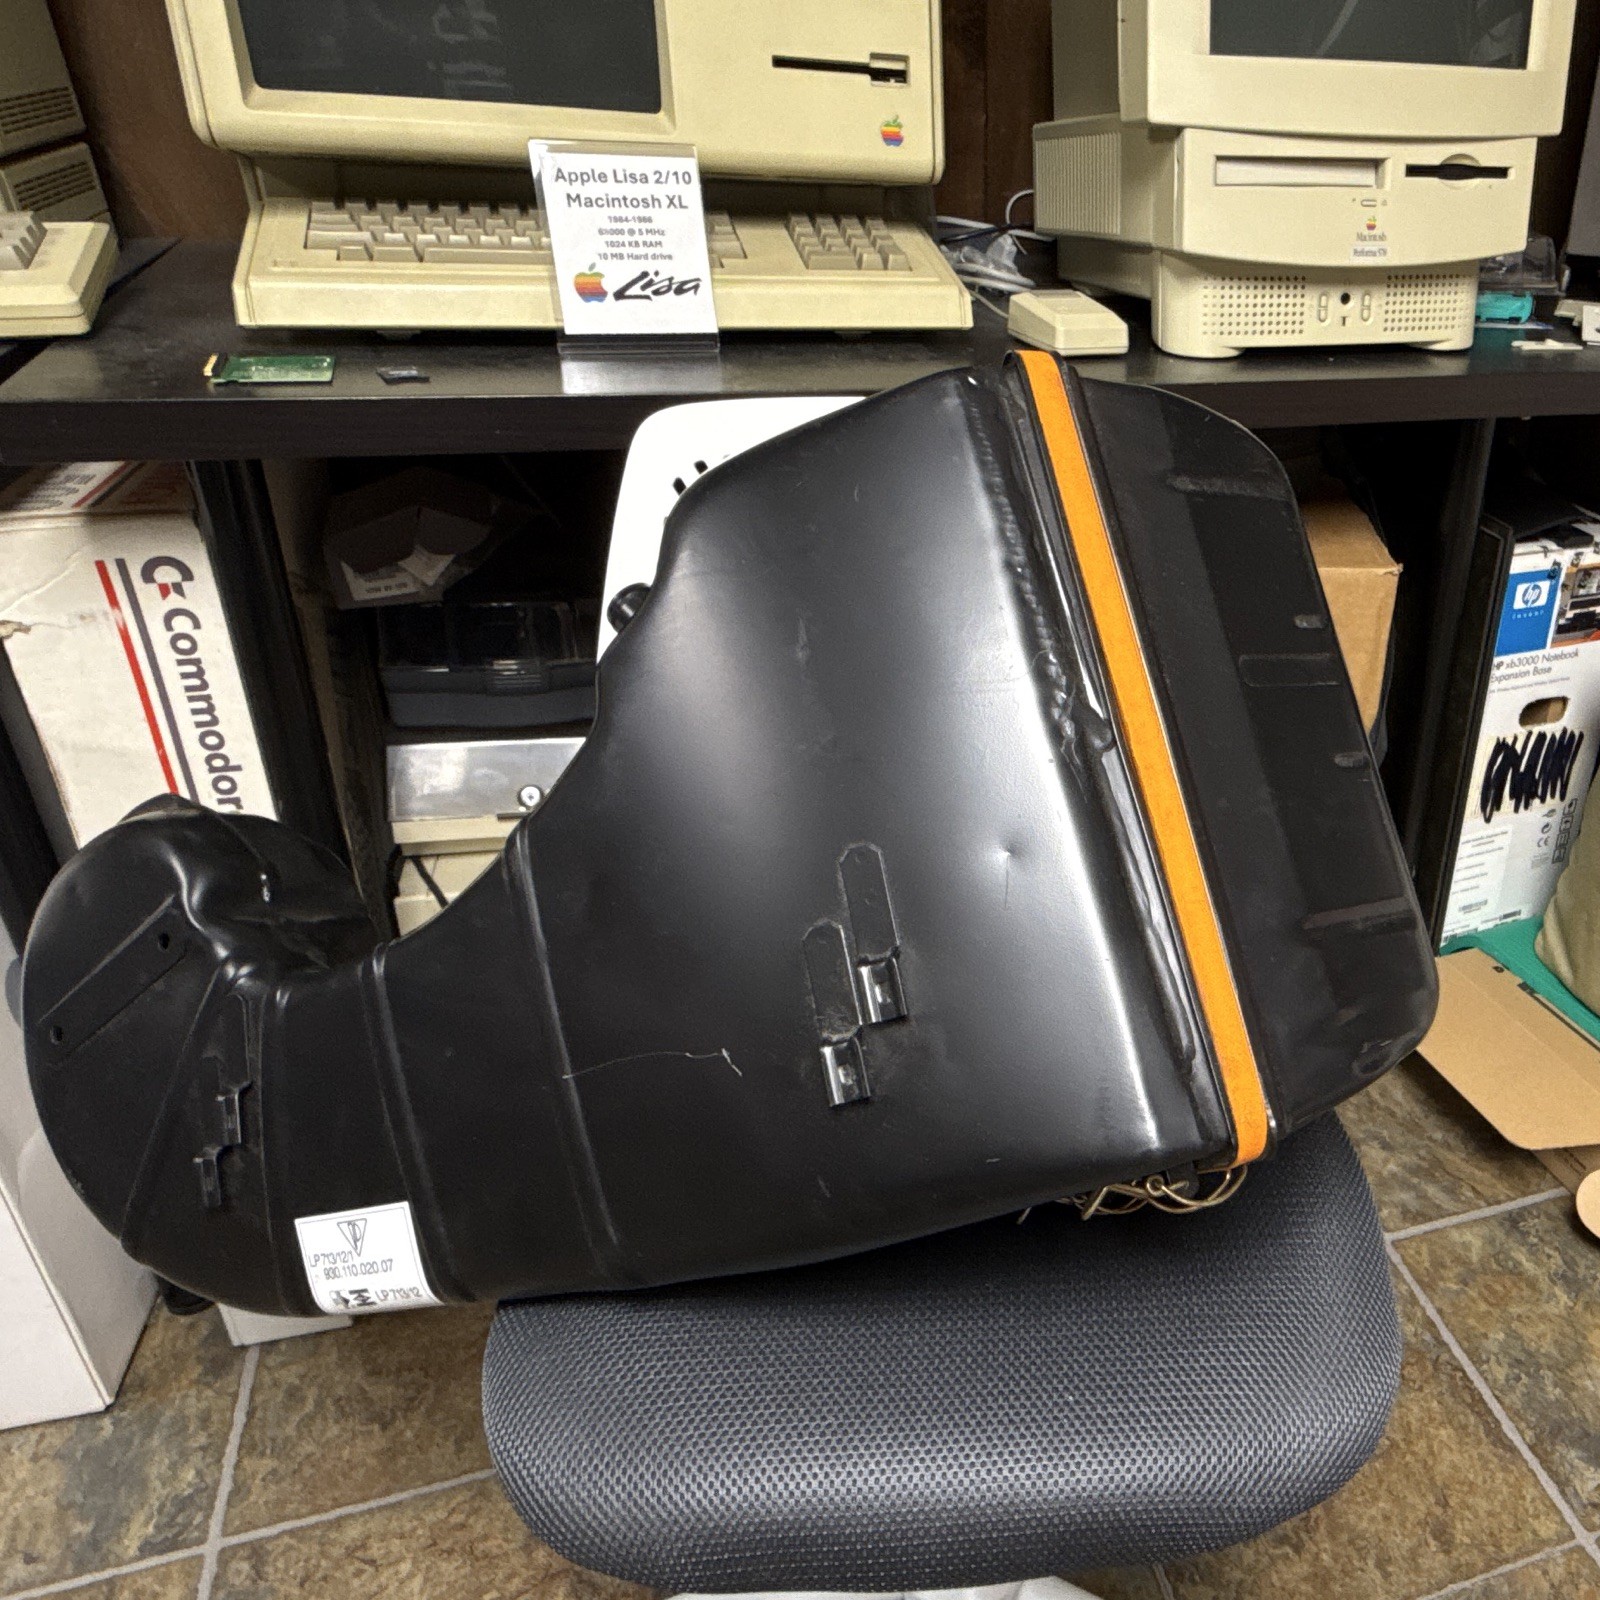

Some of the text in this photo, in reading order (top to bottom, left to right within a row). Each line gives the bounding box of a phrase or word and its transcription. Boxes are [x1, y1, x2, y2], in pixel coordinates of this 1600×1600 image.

[555, 167, 692, 186] Apple Lisa 2/10
[566, 193, 689, 209] Macintosh XL
[627, 228, 636, 237] @
[638, 228, 644, 236] 5
[645, 228, 666, 236] MHz
[604, 240, 663, 248] 1024 KB RAM
[610, 252, 625, 260] MB
[627, 252, 649, 260] Hard
[650, 252, 673, 260] drive
[613, 269, 702, 302] Lisa
[1542, 647, 1579, 663] Notebook
[1490, 665, 1552, 684] Expansion Base
[163, 607, 243, 811] Commodor
[323, 1258, 393, 1280] 930.110.020.07
